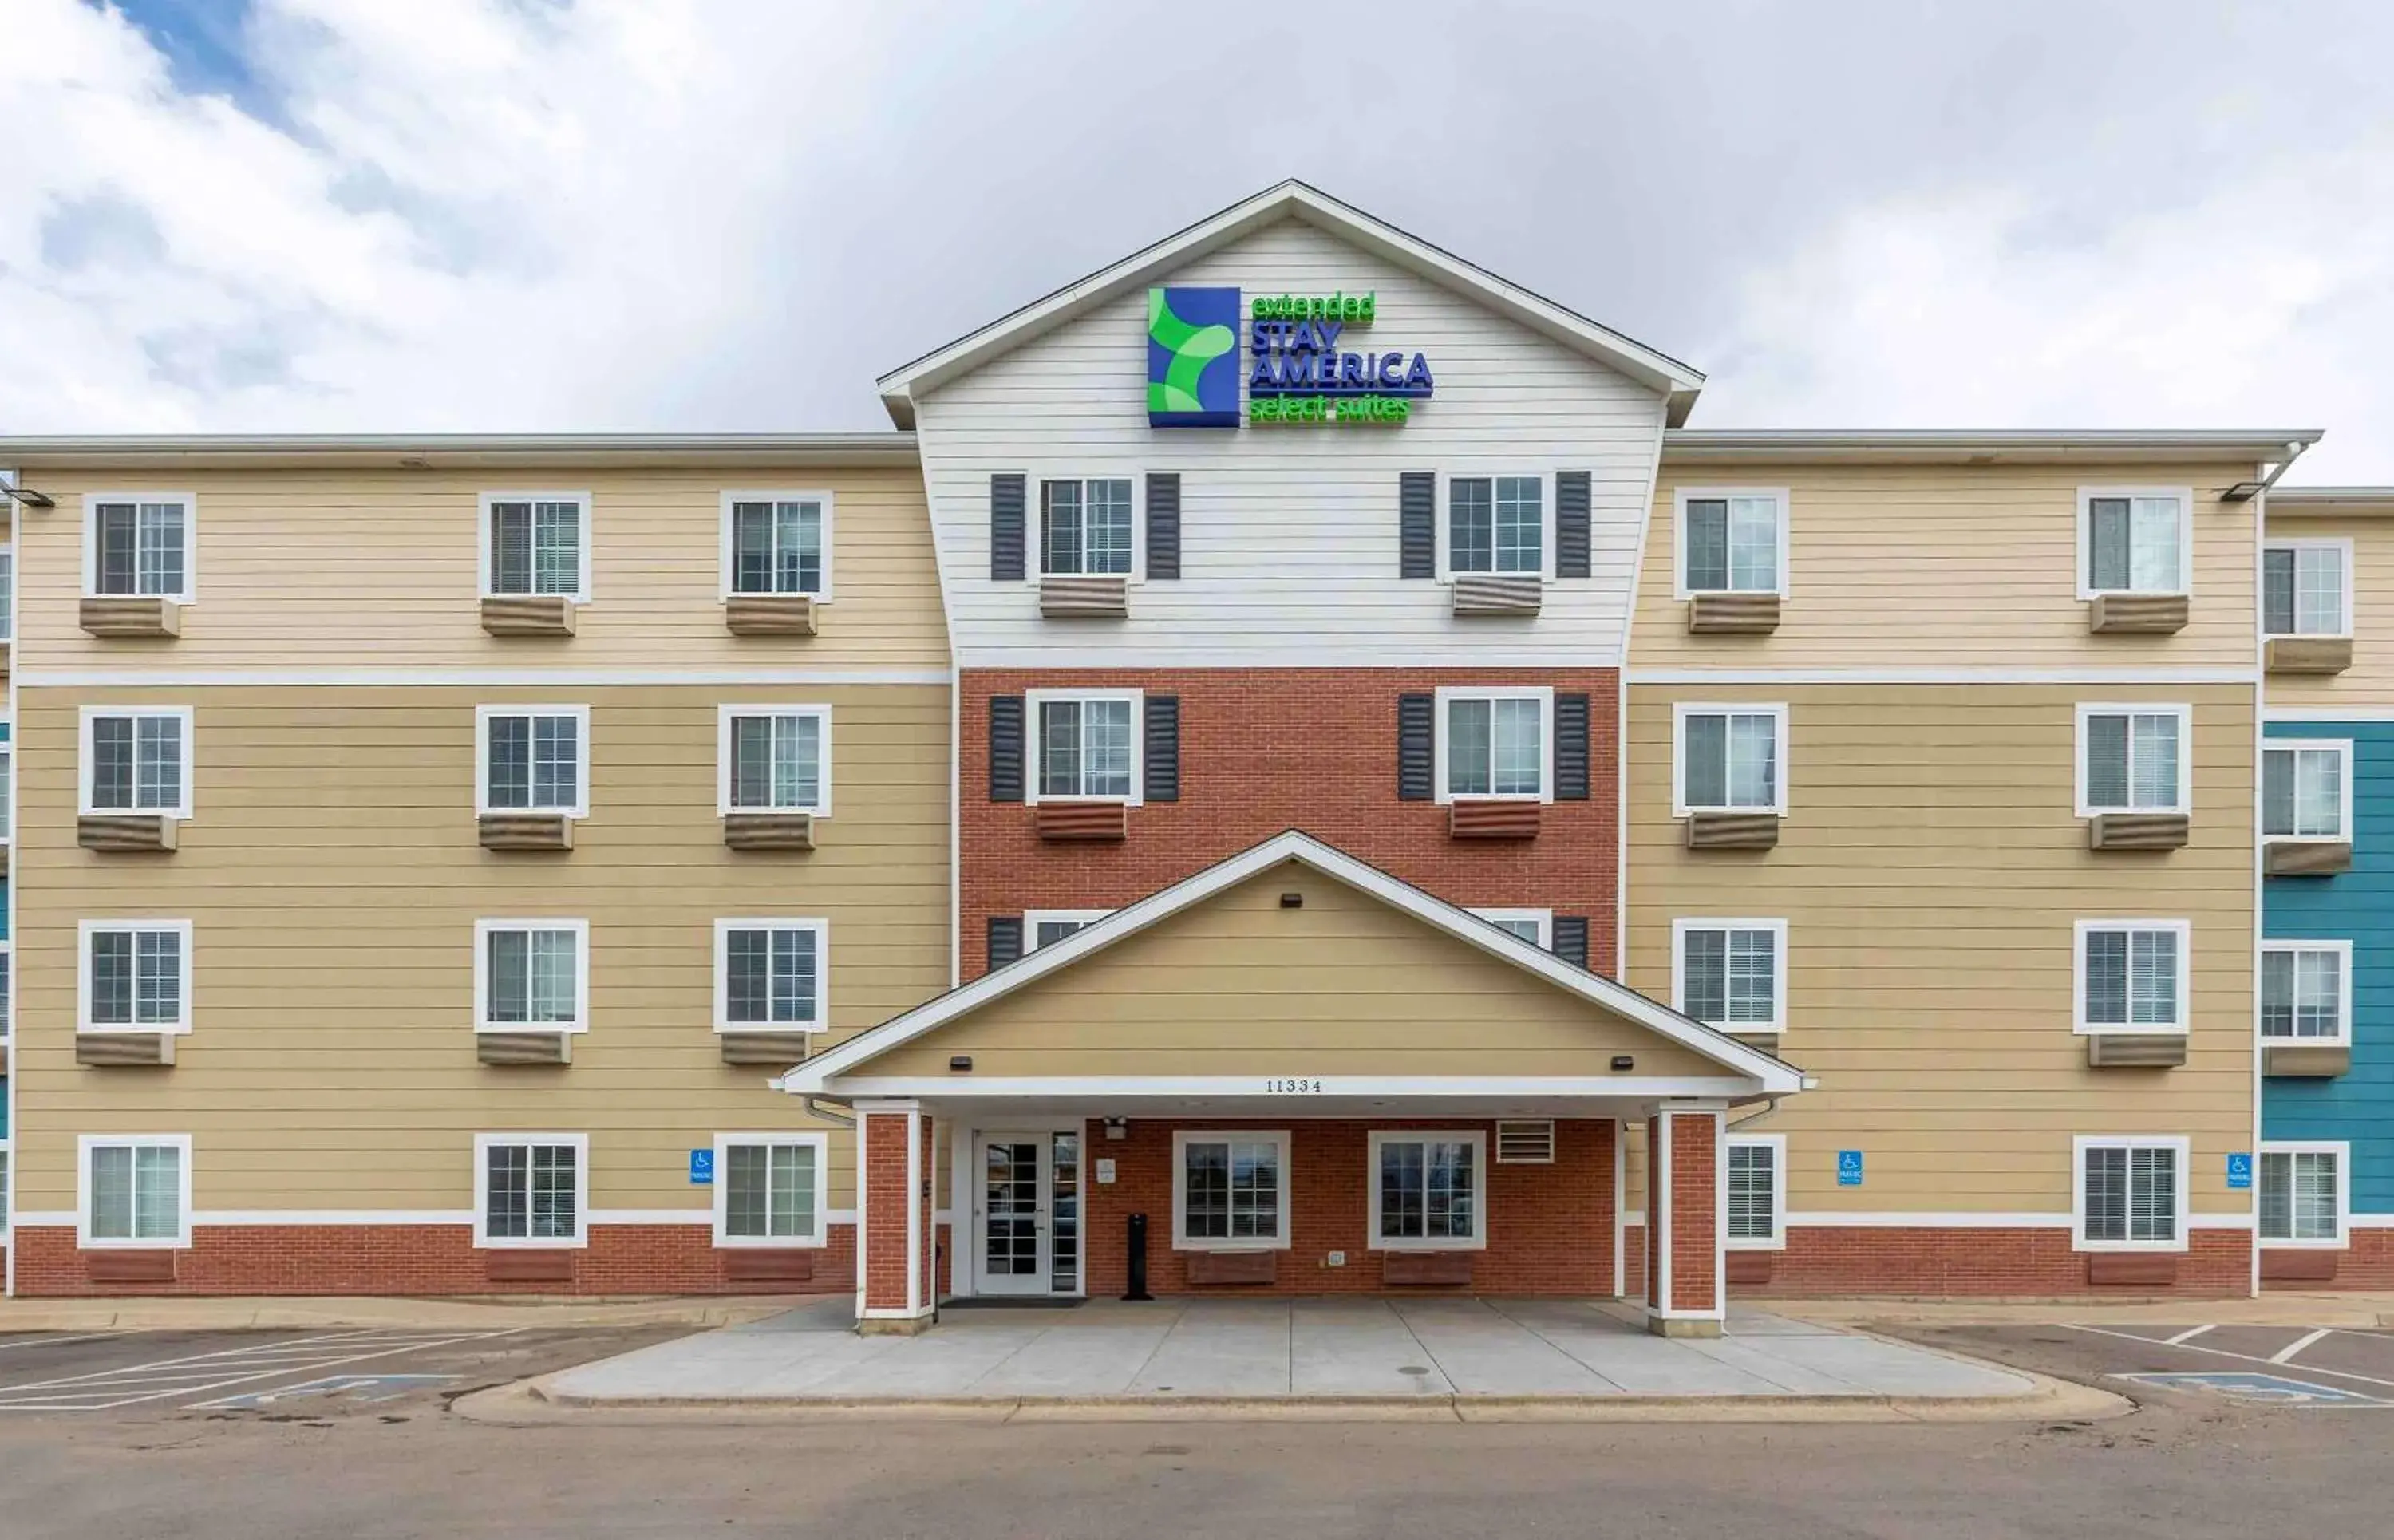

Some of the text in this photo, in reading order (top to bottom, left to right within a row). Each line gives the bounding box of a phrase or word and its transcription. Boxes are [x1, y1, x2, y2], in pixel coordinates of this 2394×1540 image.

[1252, 290, 1376, 320] extended
[1251, 321, 1342, 353] STAY
[1250, 352, 1433, 386] AMERICA
[1250, 393, 1411, 421] select suites
[1265, 1079, 1321, 1092] 11334
